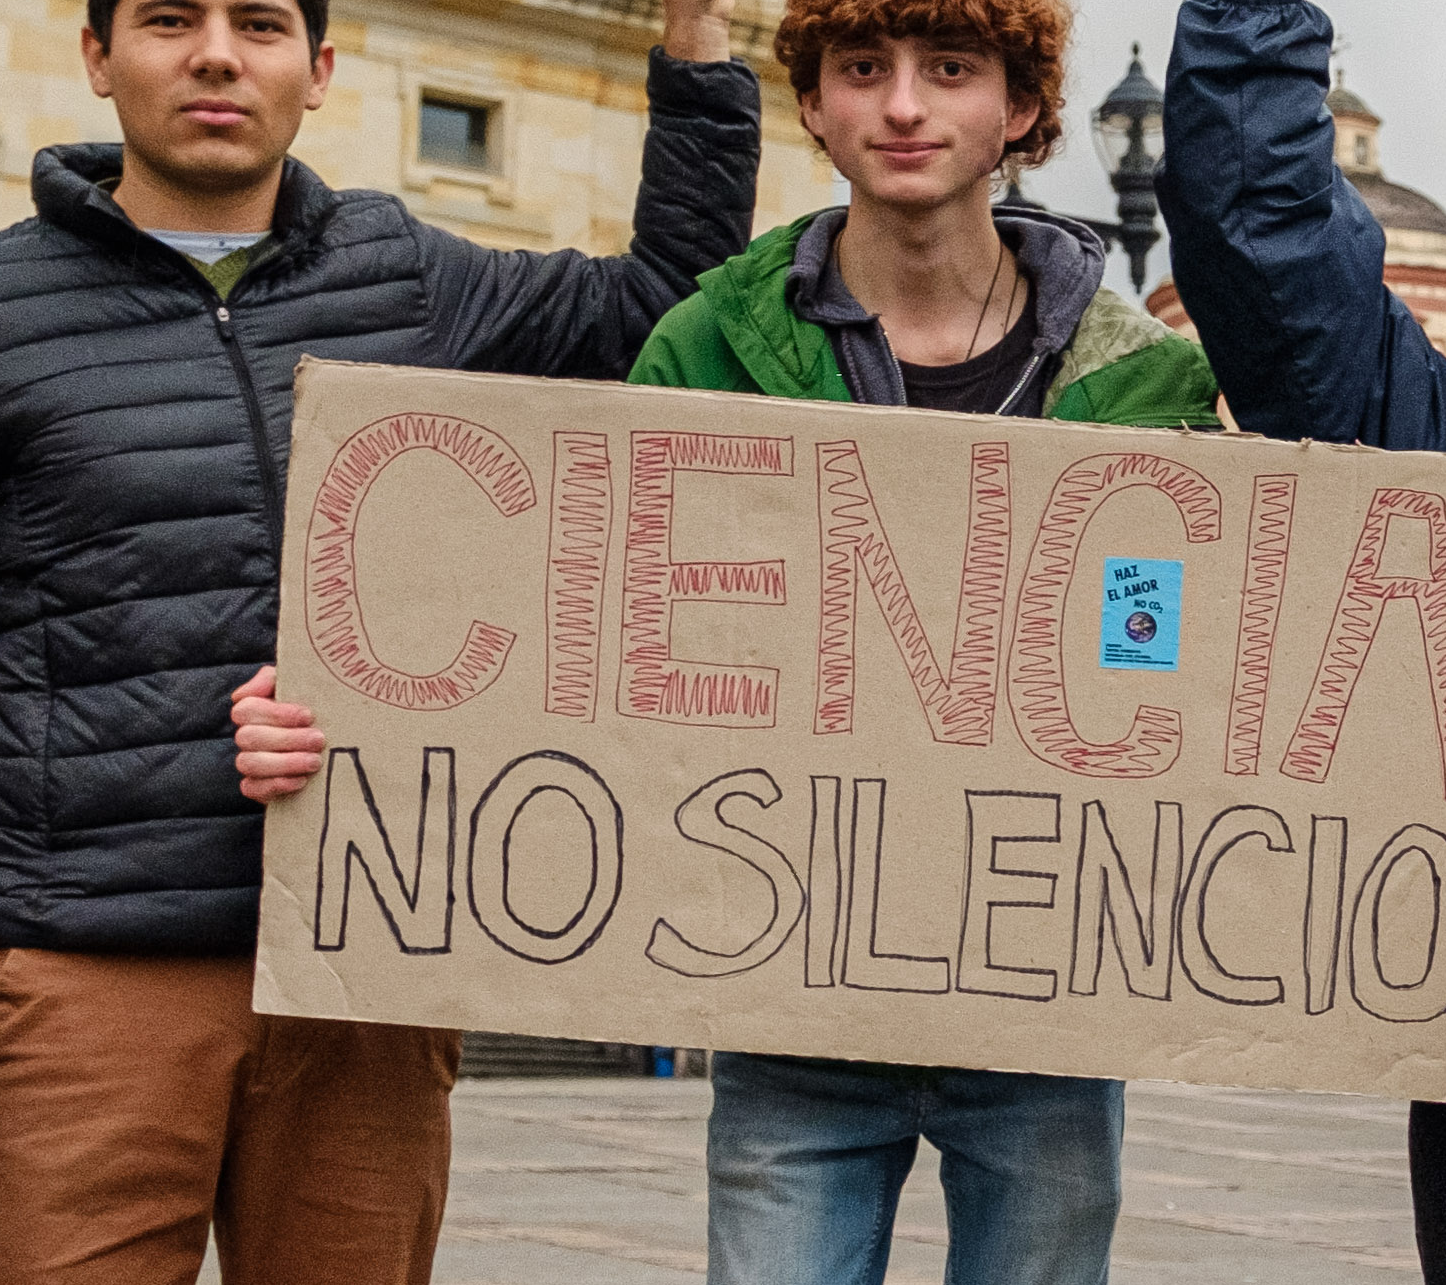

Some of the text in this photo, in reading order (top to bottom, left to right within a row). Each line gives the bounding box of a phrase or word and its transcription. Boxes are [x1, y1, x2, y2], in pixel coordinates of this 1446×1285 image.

[1114, 565, 1140, 582] HAZ
[1107, 579, 1159, 602] EL AMOR
[1134, 599, 1147, 608] NO
[314, 747, 625, 965] NO
